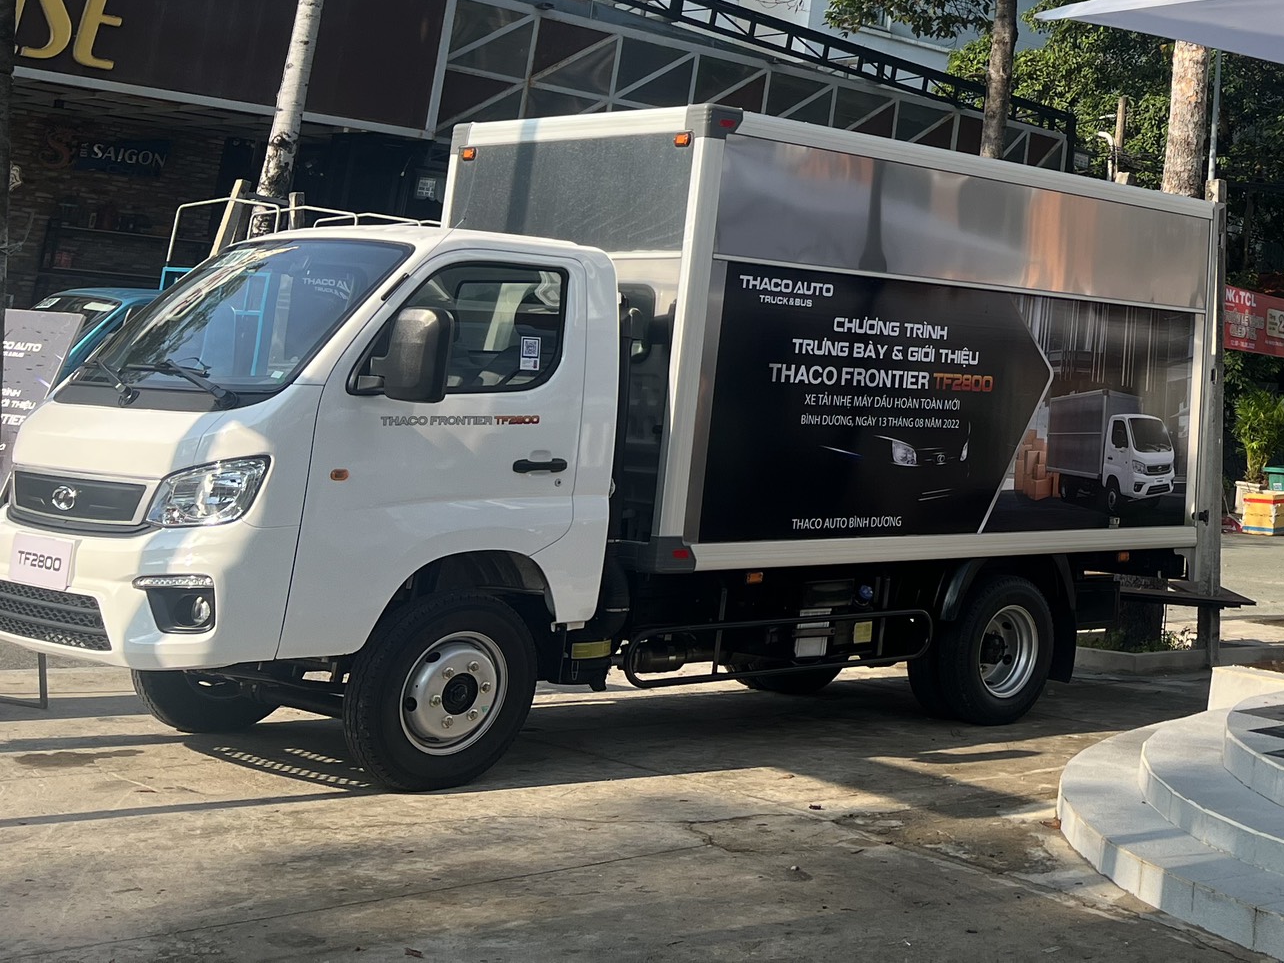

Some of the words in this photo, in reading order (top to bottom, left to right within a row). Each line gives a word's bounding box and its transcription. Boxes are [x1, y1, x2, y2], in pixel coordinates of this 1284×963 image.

[91, 143, 167, 168] SAIGON
[739, 274, 792, 293] THACO
[793, 281, 834, 297] AUTO
[759, 294, 813, 308] TRUCK&BUS
[833, 316, 900, 337] CHƯƠNG
[904, 321, 948, 340] TRÌNH
[792, 337, 849, 357] TRƯNG
[853, 341, 888, 359] BÀY
[892, 346, 903, 360] &
[908, 343, 936, 363] GIỚI
[939, 347, 980, 368] THIỆU
[769, 363, 838, 386] THACO
[840, 367, 930, 390] FRONTIER
[933, 372, 994, 392] TF2800
[804, 393, 817, 405] XE
[817, 391, 831, 406] TẢI
[832, 394, 852, 410] NHẸ
[853, 394, 873, 407] MÁY
[894, 396, 919, 410] HOÀN
[920, 397, 943, 410] TOÀN
[944, 398, 961, 411] MỚI
[380, 416, 428, 426] THACO
[429, 416, 493, 426] FRONTIER
[493, 415, 540, 425] TF2800
[800, 414, 821, 425] BÌNH
[855, 414, 877, 427] NGÀY
[878, 417, 887, 427] 13
[888, 415, 914, 427] THÁNG
[914, 418, 924, 428] 08
[925, 416, 942, 428] NĂM
[943, 418, 960, 429] 2022
[792, 518, 822, 529] THACO
[823, 517, 847, 528] AUTO
[849, 515, 869, 528] BÌNH
[870, 515, 902, 528] DƯƠNG
[18, 550, 62, 572] TF2800
